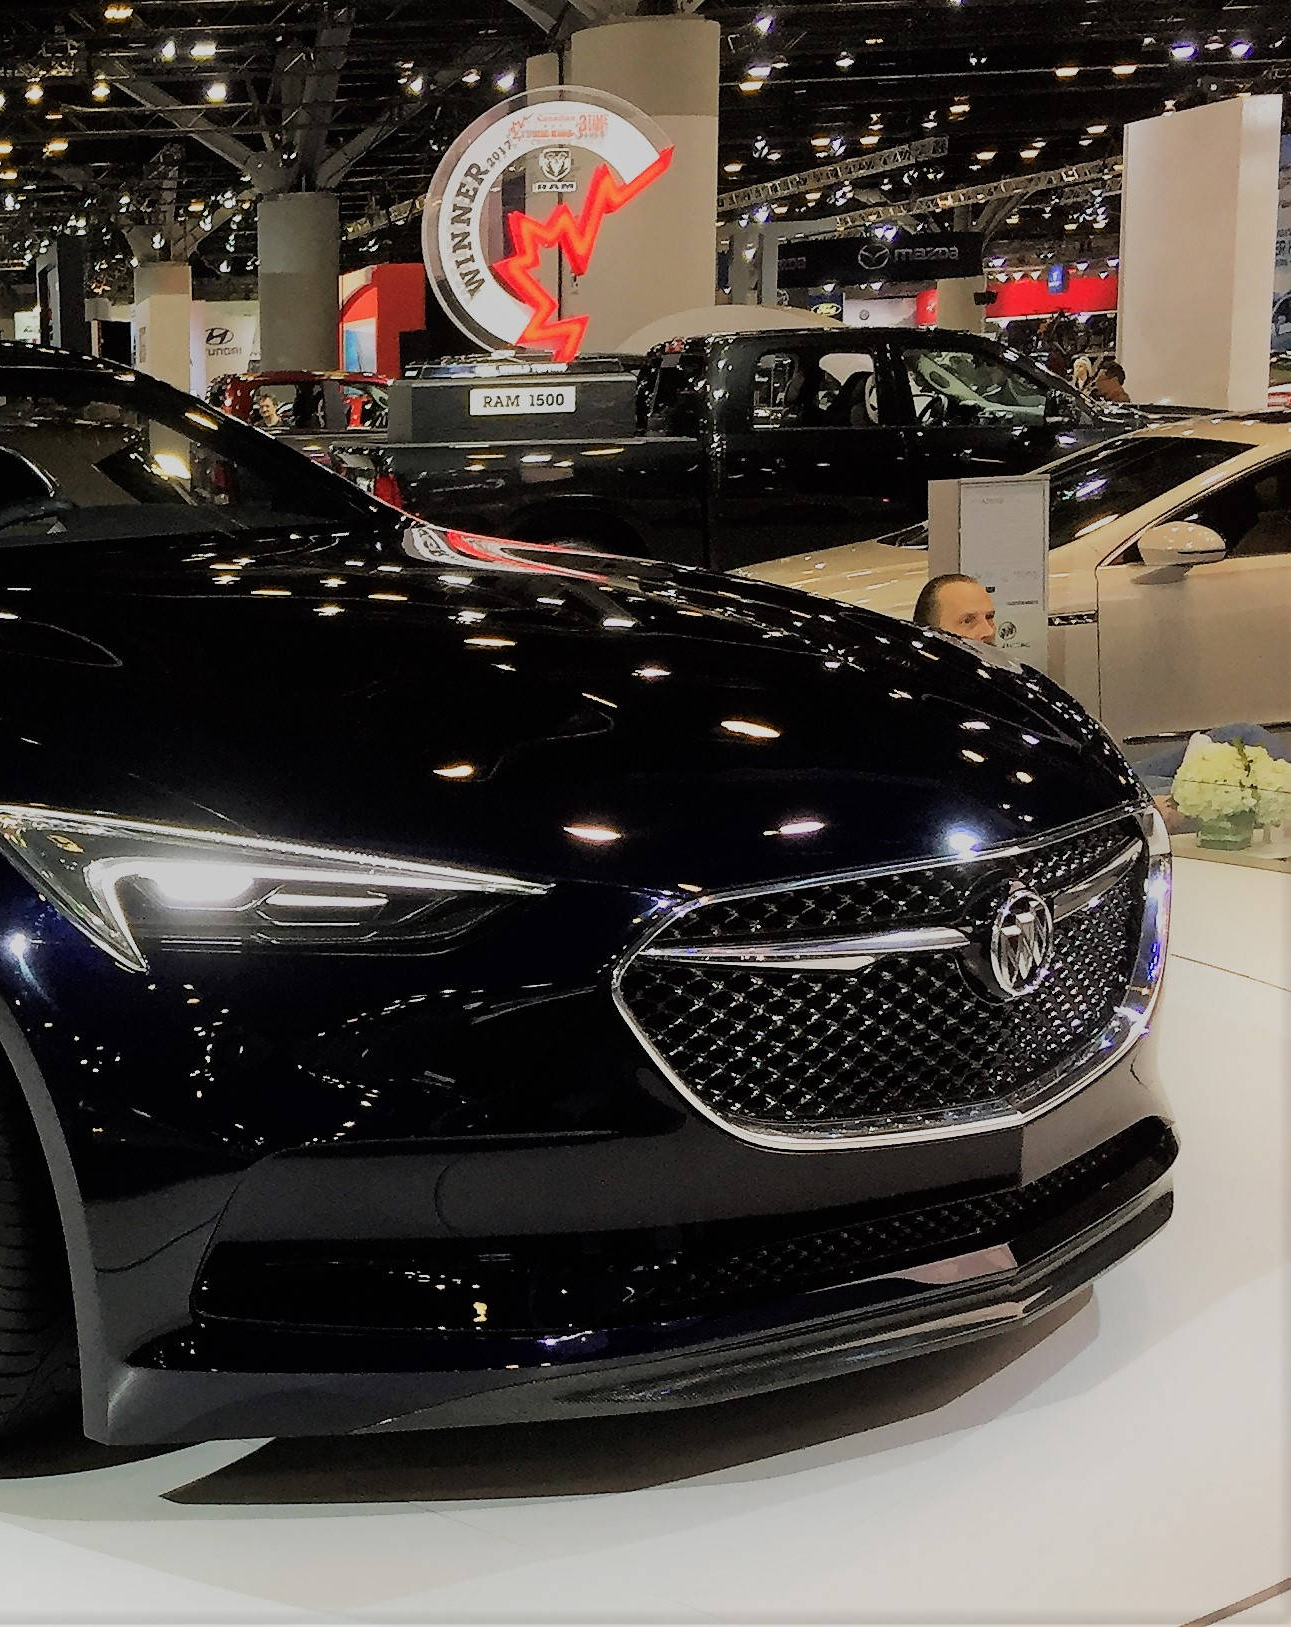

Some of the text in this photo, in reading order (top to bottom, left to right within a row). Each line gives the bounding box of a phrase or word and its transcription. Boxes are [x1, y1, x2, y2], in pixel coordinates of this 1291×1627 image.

[451, 139, 512, 298] WINNER 2017
[482, 393, 565, 408] RAM 1500
